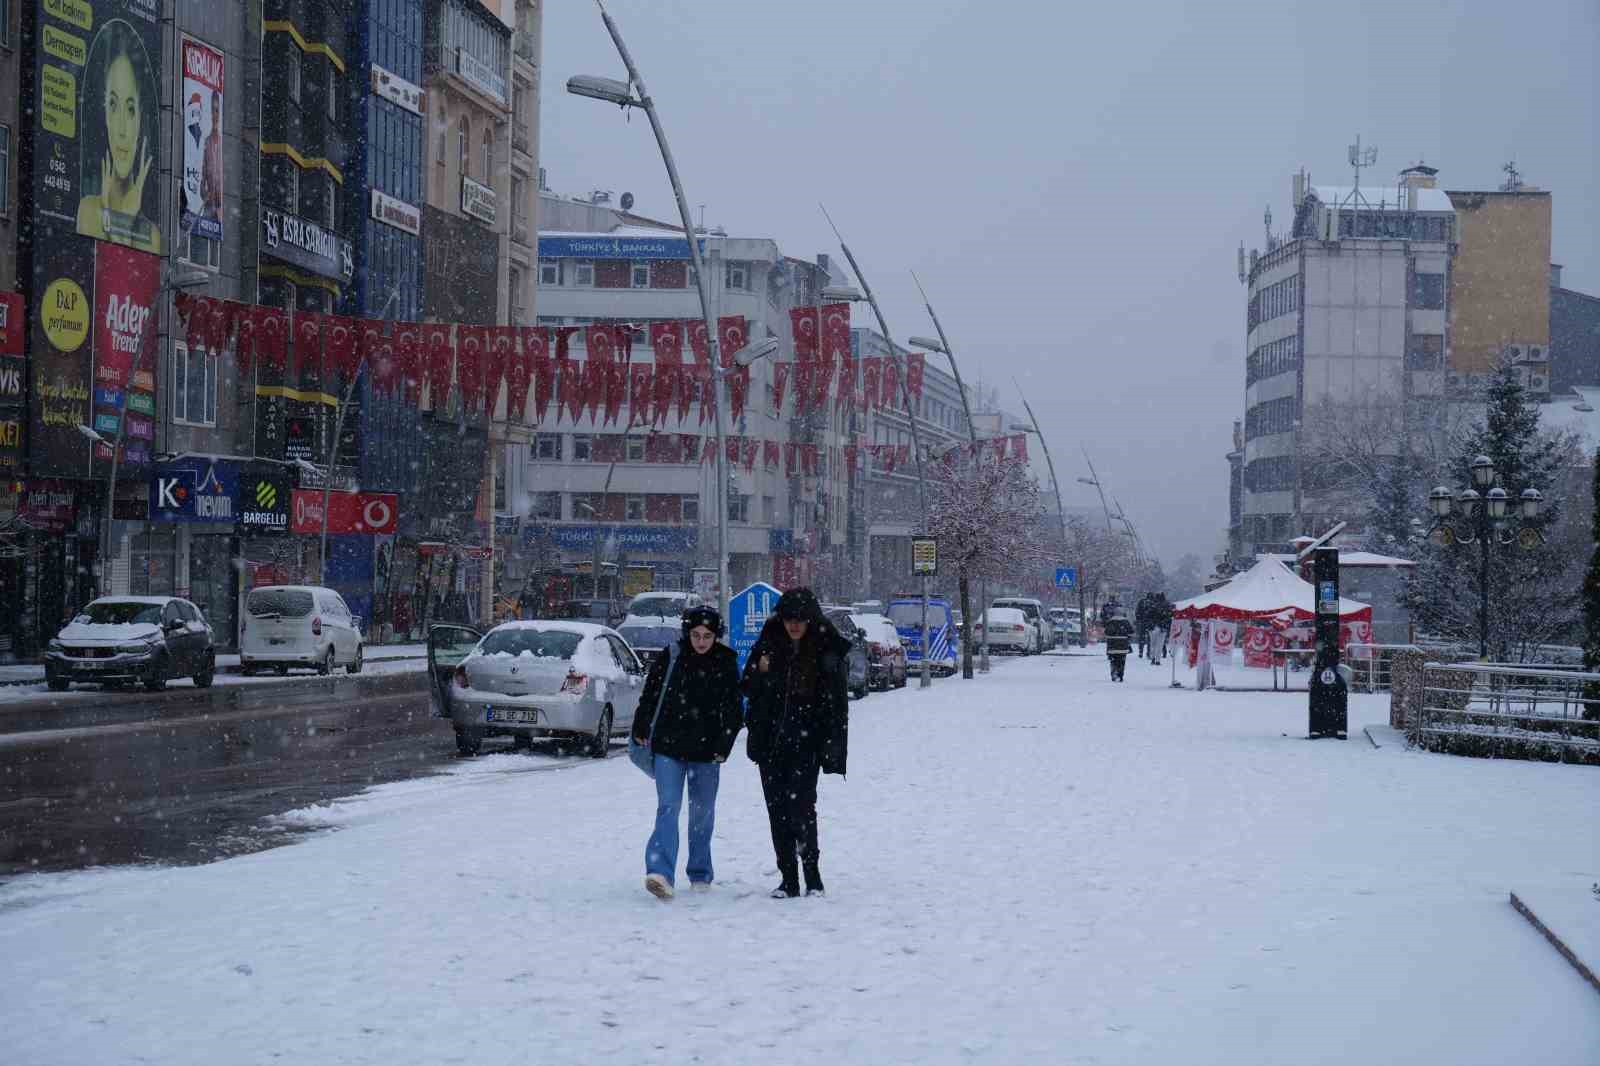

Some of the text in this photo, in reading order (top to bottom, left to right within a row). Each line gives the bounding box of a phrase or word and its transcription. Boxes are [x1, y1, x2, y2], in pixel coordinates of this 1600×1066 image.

[283, 215, 304, 248] ESRA
[55, 288, 78, 311] D&P
[105, 293, 150, 334] Ader
[112, 330, 140, 354] Trend
[242, 512, 287, 526] BARGELLO
